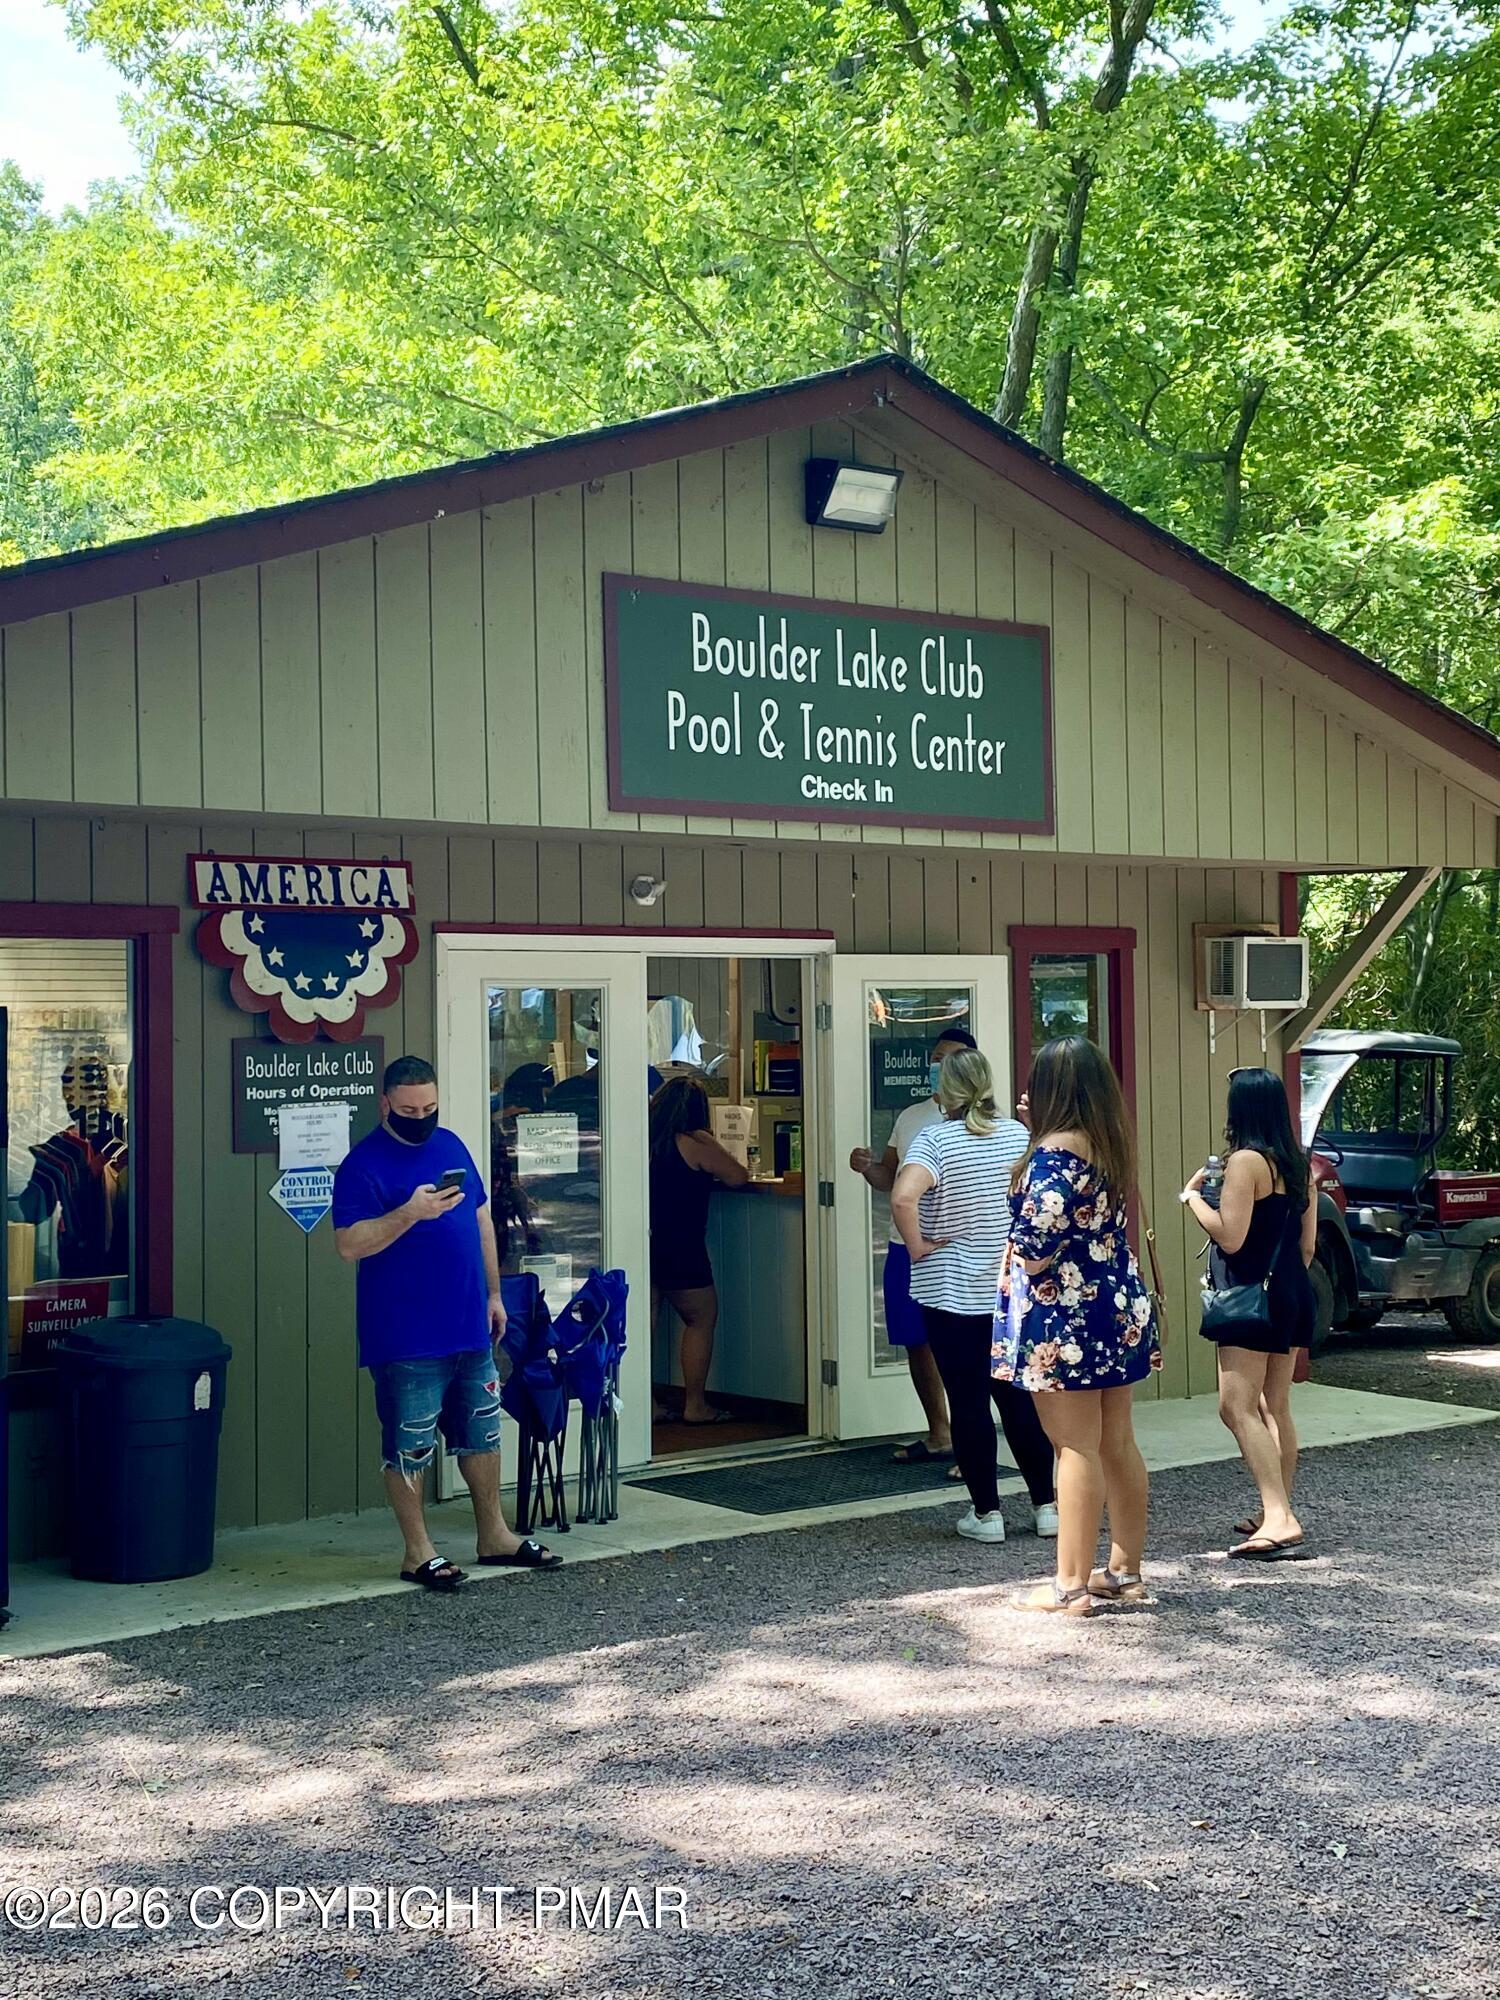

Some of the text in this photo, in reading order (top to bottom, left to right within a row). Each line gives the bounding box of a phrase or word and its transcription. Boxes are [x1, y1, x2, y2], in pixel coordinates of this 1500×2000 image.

[691, 612, 985, 699] Boulder Lake Club
[667, 690, 1006, 775] Pool & Tennis Center
[800, 774, 893, 802] Check In
[206, 862, 400, 907] AMERICA
[245, 1050, 374, 1078] Boulder Lake Club
[884, 1048, 921, 1069] Boulder
[884, 1076, 922, 1086] MEMBERS
[246, 1083, 374, 1100] Hours of Operation
[910, 1087, 933, 1097] CHEC
[264, 1107, 278, 1116] Mo
[523, 1142, 562, 1150] REQUED
[534, 1156, 561, 1165] OFFICE
[281, 1175, 333, 1187] CONTROL
[279, 1186, 333, 1199] SECURITY
[1446, 1191, 1487, 1203] Kawasaki
[46, 1298, 87, 1313] CAMERA
[47, 1338, 59, 1350] IN
